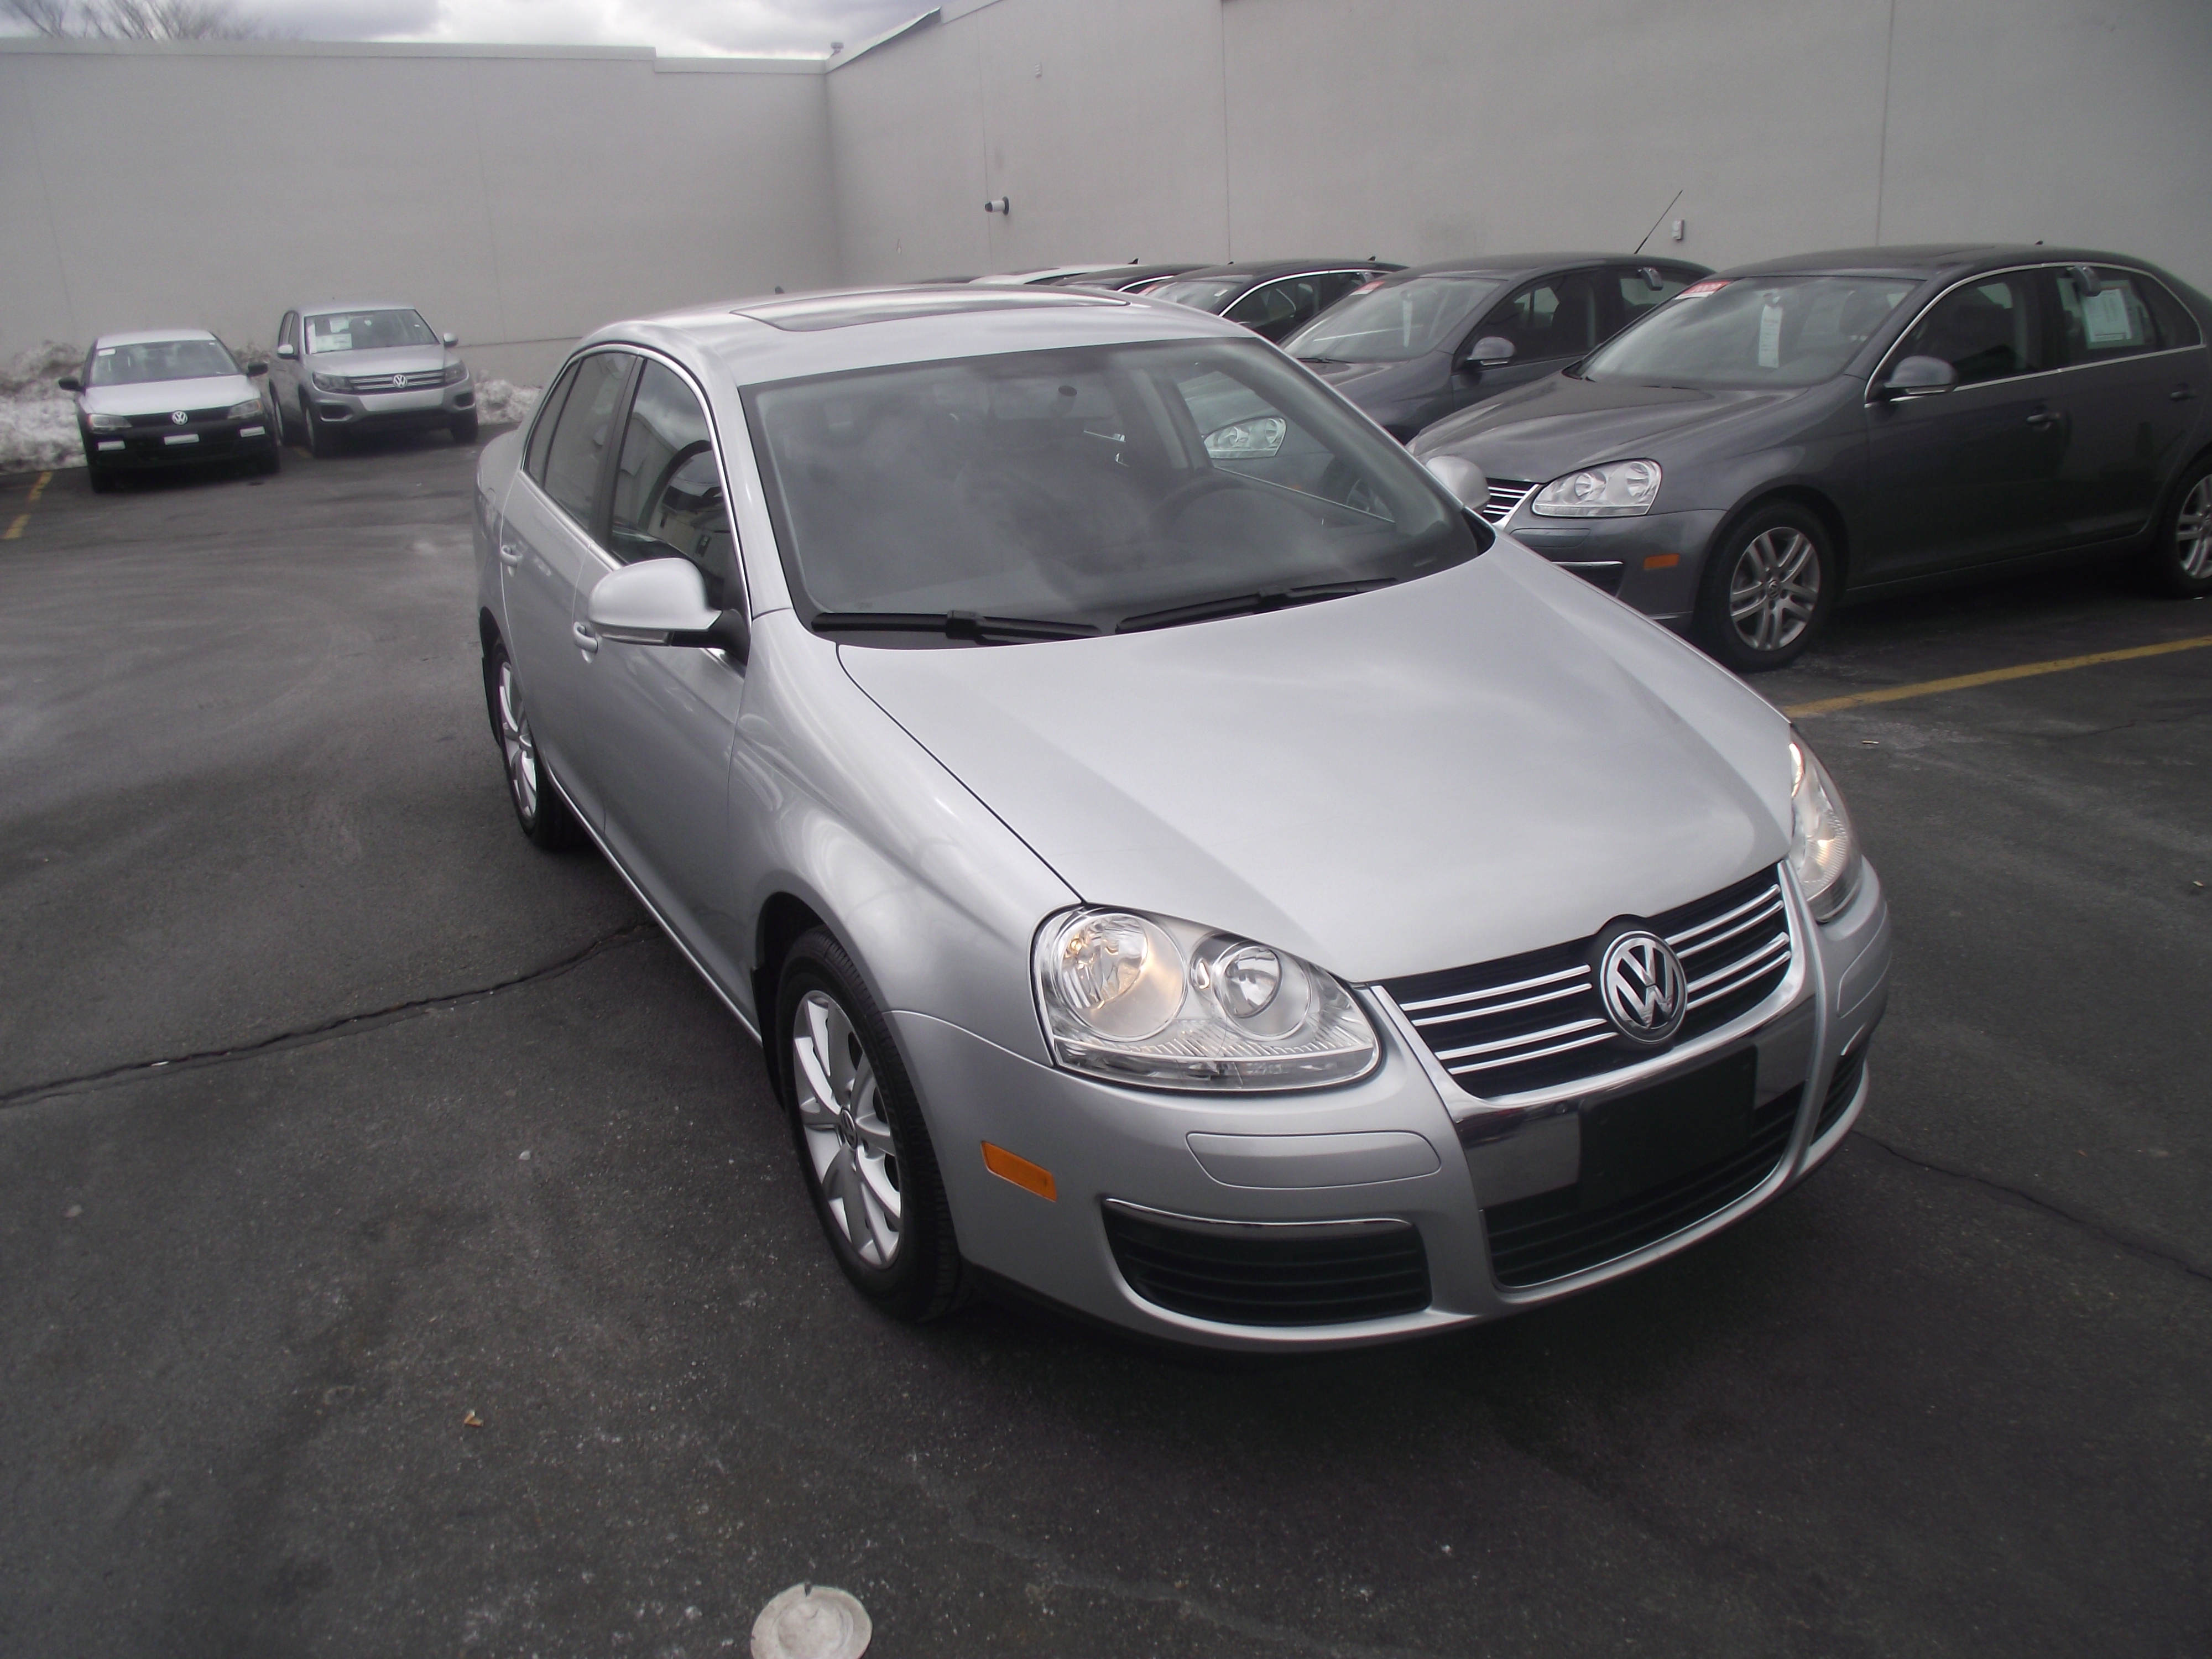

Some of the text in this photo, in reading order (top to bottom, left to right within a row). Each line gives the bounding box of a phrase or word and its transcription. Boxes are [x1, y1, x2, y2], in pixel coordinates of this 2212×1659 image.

[394, 374, 408, 388] VW
[172, 411, 188, 425] VW
[1605, 936, 1681, 1031] VW
